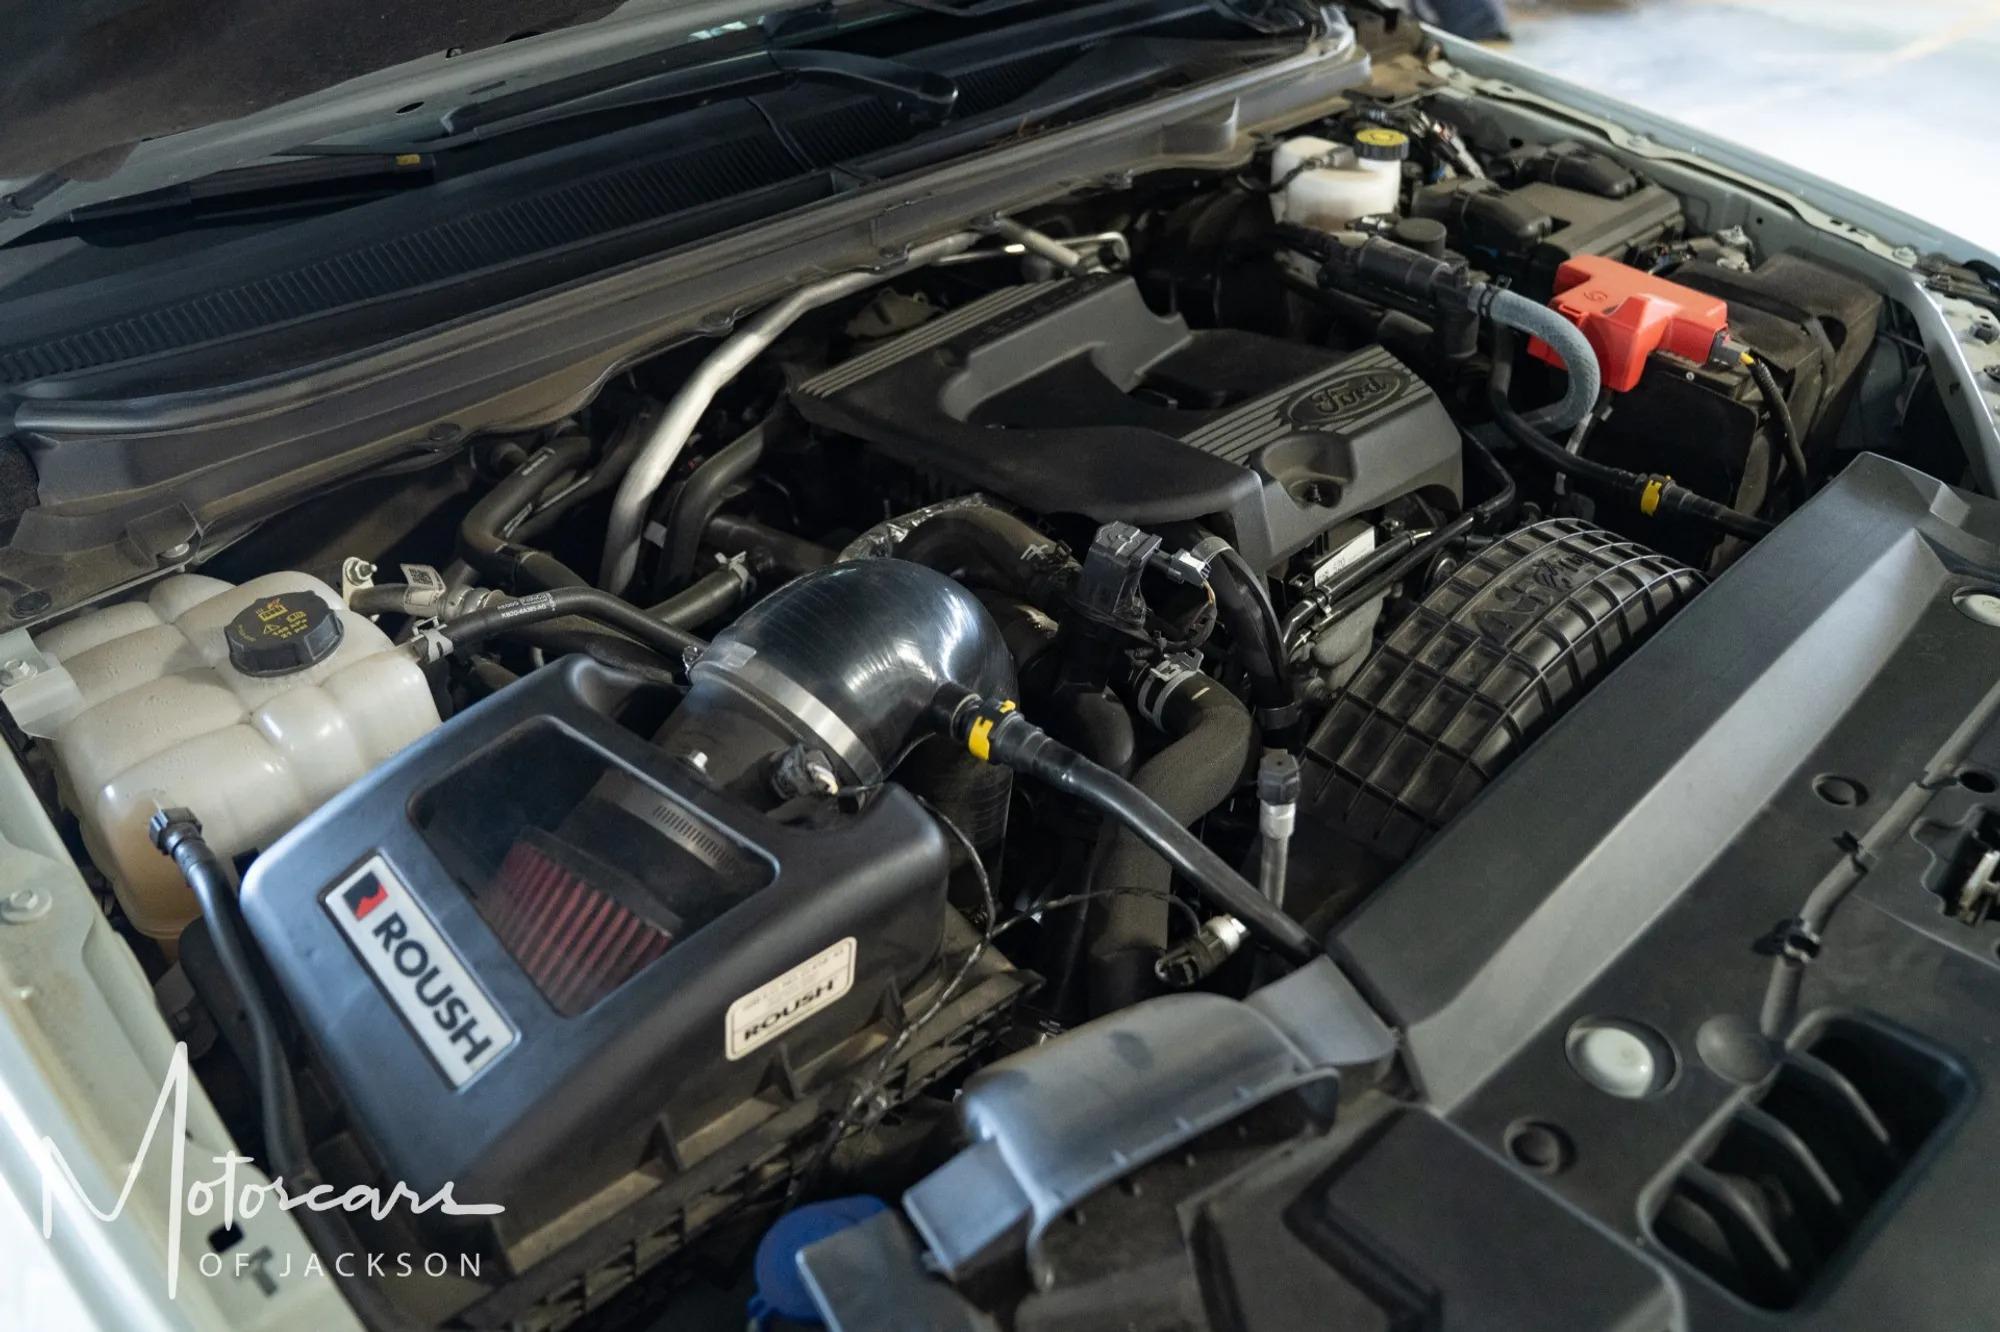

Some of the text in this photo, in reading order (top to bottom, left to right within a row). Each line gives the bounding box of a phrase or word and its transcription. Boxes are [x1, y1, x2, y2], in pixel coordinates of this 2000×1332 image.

[1310, 374, 1389, 415] Ford
[372, 911, 492, 1064] ROUSH
[744, 979, 834, 1041] ROUSH
